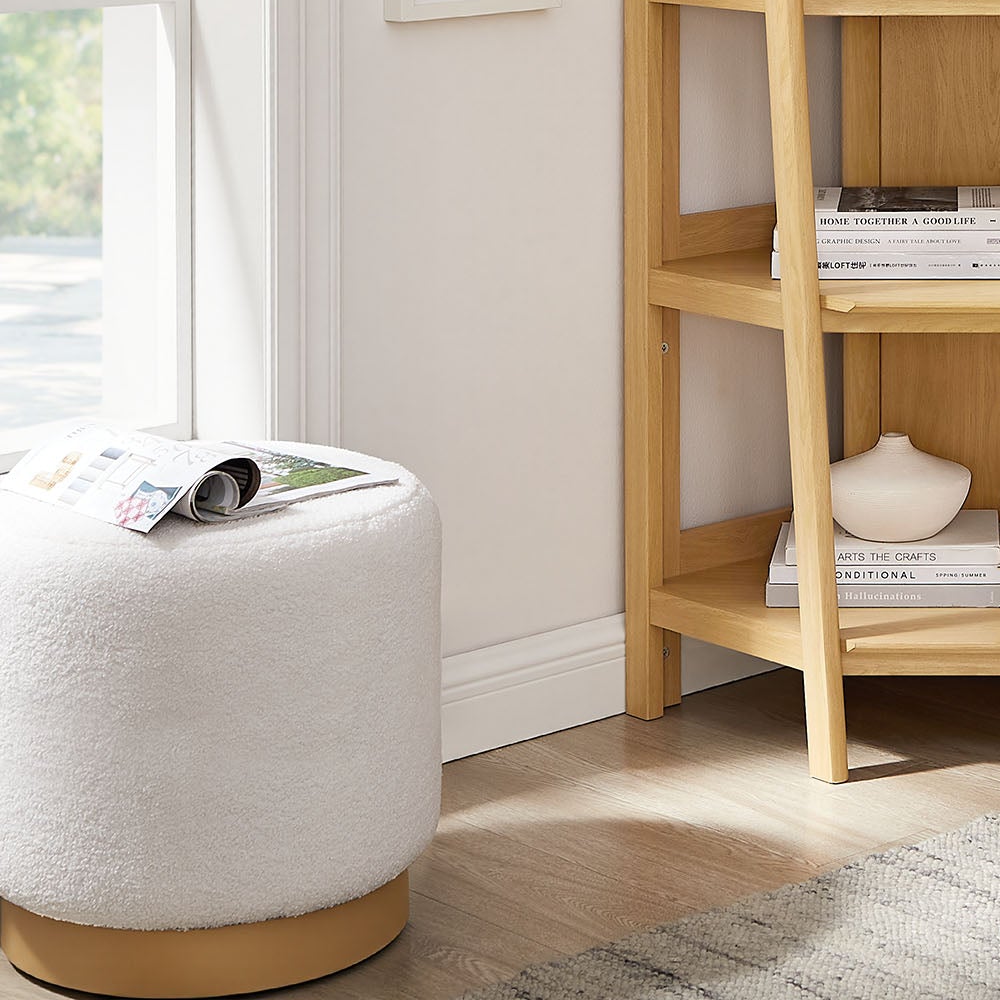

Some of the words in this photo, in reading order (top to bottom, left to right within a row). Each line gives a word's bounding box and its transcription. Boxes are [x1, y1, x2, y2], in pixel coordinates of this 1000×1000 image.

[923, 217, 951, 225] GOOD
[837, 553, 865, 561] ARTS
[870, 553, 890, 561] THE
[895, 553, 936, 561] CRAFTS
[836, 571, 915, 579] ONDITIONAL
[846, 592, 921, 600] Hallucinations
